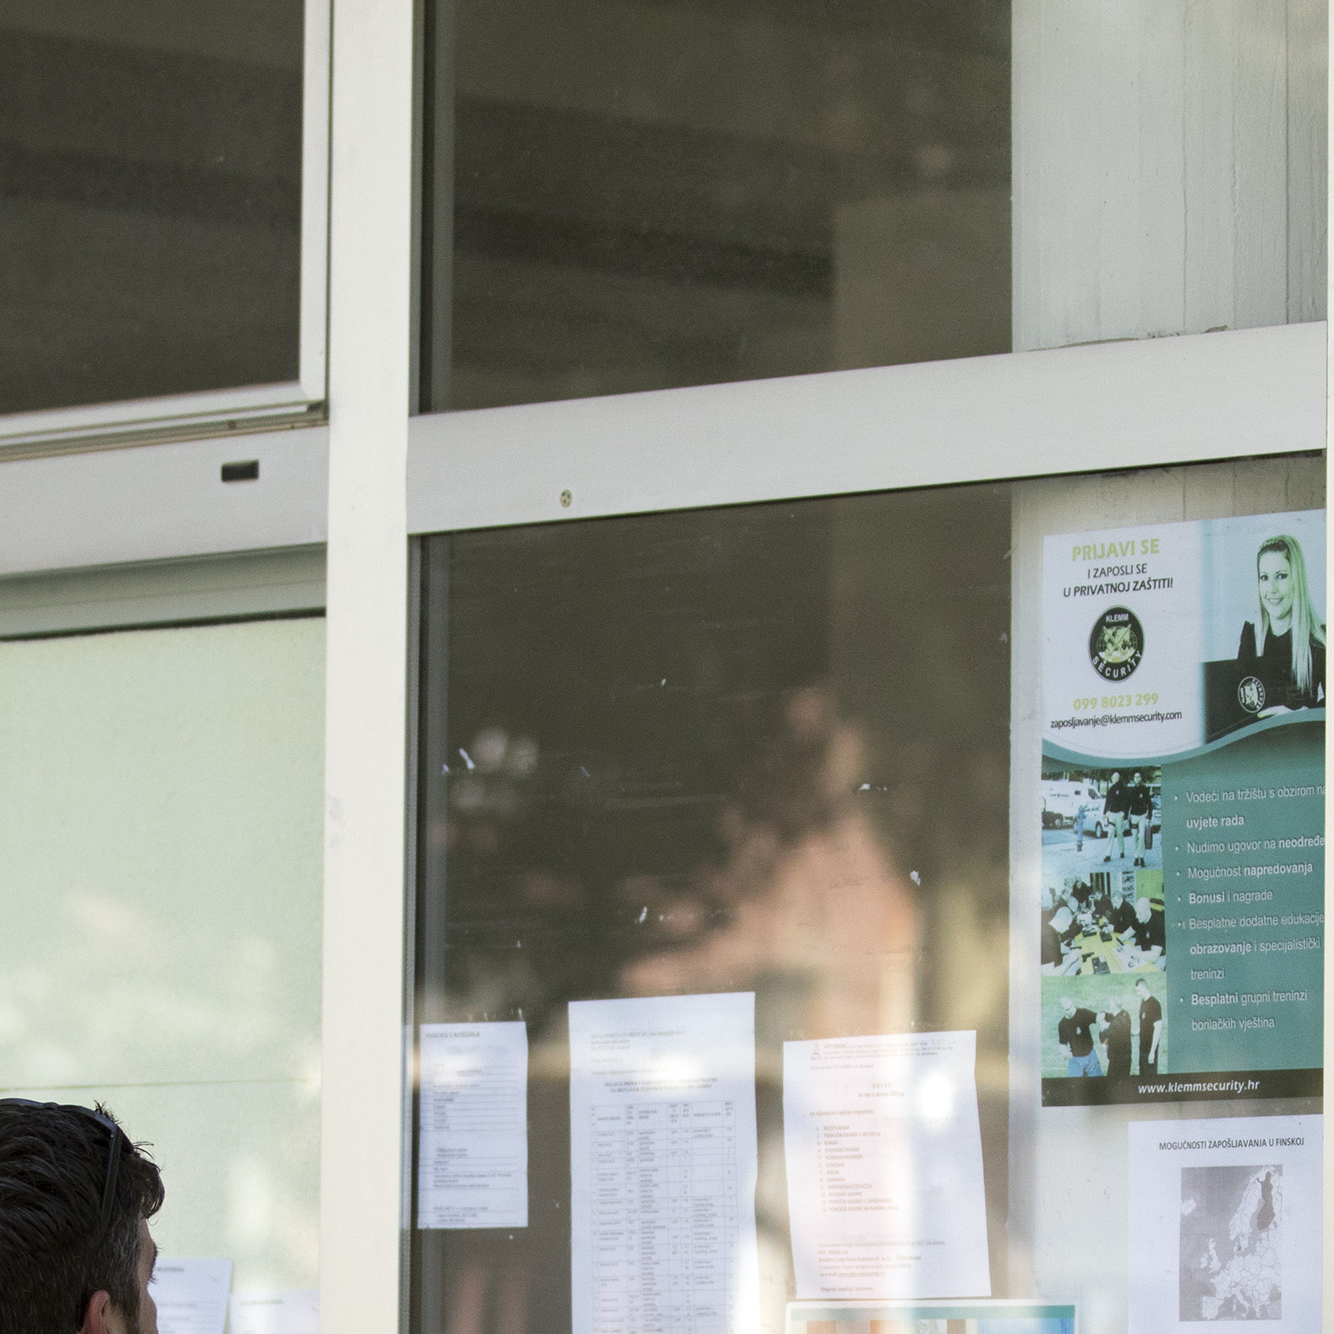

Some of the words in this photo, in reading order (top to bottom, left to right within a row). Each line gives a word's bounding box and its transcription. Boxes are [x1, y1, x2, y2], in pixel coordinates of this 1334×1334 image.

[1072, 540, 1134, 561] PRIJAVI
[1142, 538, 1159, 555] SE
[1093, 565, 1133, 578] ZAPOSLI
[1136, 563, 1147, 574] SE
[1063, 588, 1071, 598] U
[1073, 582, 1130, 596] PRIVATNOJ
[1133, 578, 1173, 592] ZAŠTITI!
[1106, 613, 1129, 623] KLEMM
[1092, 650, 1142, 678] SECURITY
[1073, 697, 1097, 710] 099
[1102, 695, 1131, 708] 8023
[1137, 692, 1159, 706] 299
[1186, 791, 1219, 803] Vodeći
[1223, 792, 1234, 801] na
[1238, 788, 1266, 800] tržištu
[1278, 786, 1314, 798] obzirom
[1186, 817, 1218, 830] uvjete
[1222, 814, 1244, 827] rada
[1187, 842, 1225, 853] Nudimo
[1229, 841, 1262, 854] ugovor
[1265, 840, 1275, 849] na
[1188, 866, 1241, 881] Mogućnost
[1244, 863, 1313, 878] napredovanja
[1189, 891, 1224, 904] Bonusi
[1233, 890, 1273, 904] nagrade
[1188, 918, 1236, 932] Besplatne
[1240, 916, 1278, 927] dodatne
[1190, 941, 1251, 955] obrazovanje
[1260, 938, 1321, 953] specijalistički
[1191, 968, 1225, 980] treninzi
[1191, 992, 1238, 1007] Besplatni
[1241, 992, 1270, 1006] grupni
[1272, 990, 1308, 1002] treninzi
[1191, 1018, 1235, 1031] borilačkih
[1240, 1017, 1275, 1031] vještina
[1138, 1080, 1260, 1094] www.klemmsecurity.hr
[1159, 1140, 1207, 1150] MOGUĆNOSTI
[1209, 1138, 1266, 1149] ZAPOŠLJAVANJA
[1268, 1139, 1274, 1147] U
[1276, 1137, 1304, 1146] FINSKOJ
